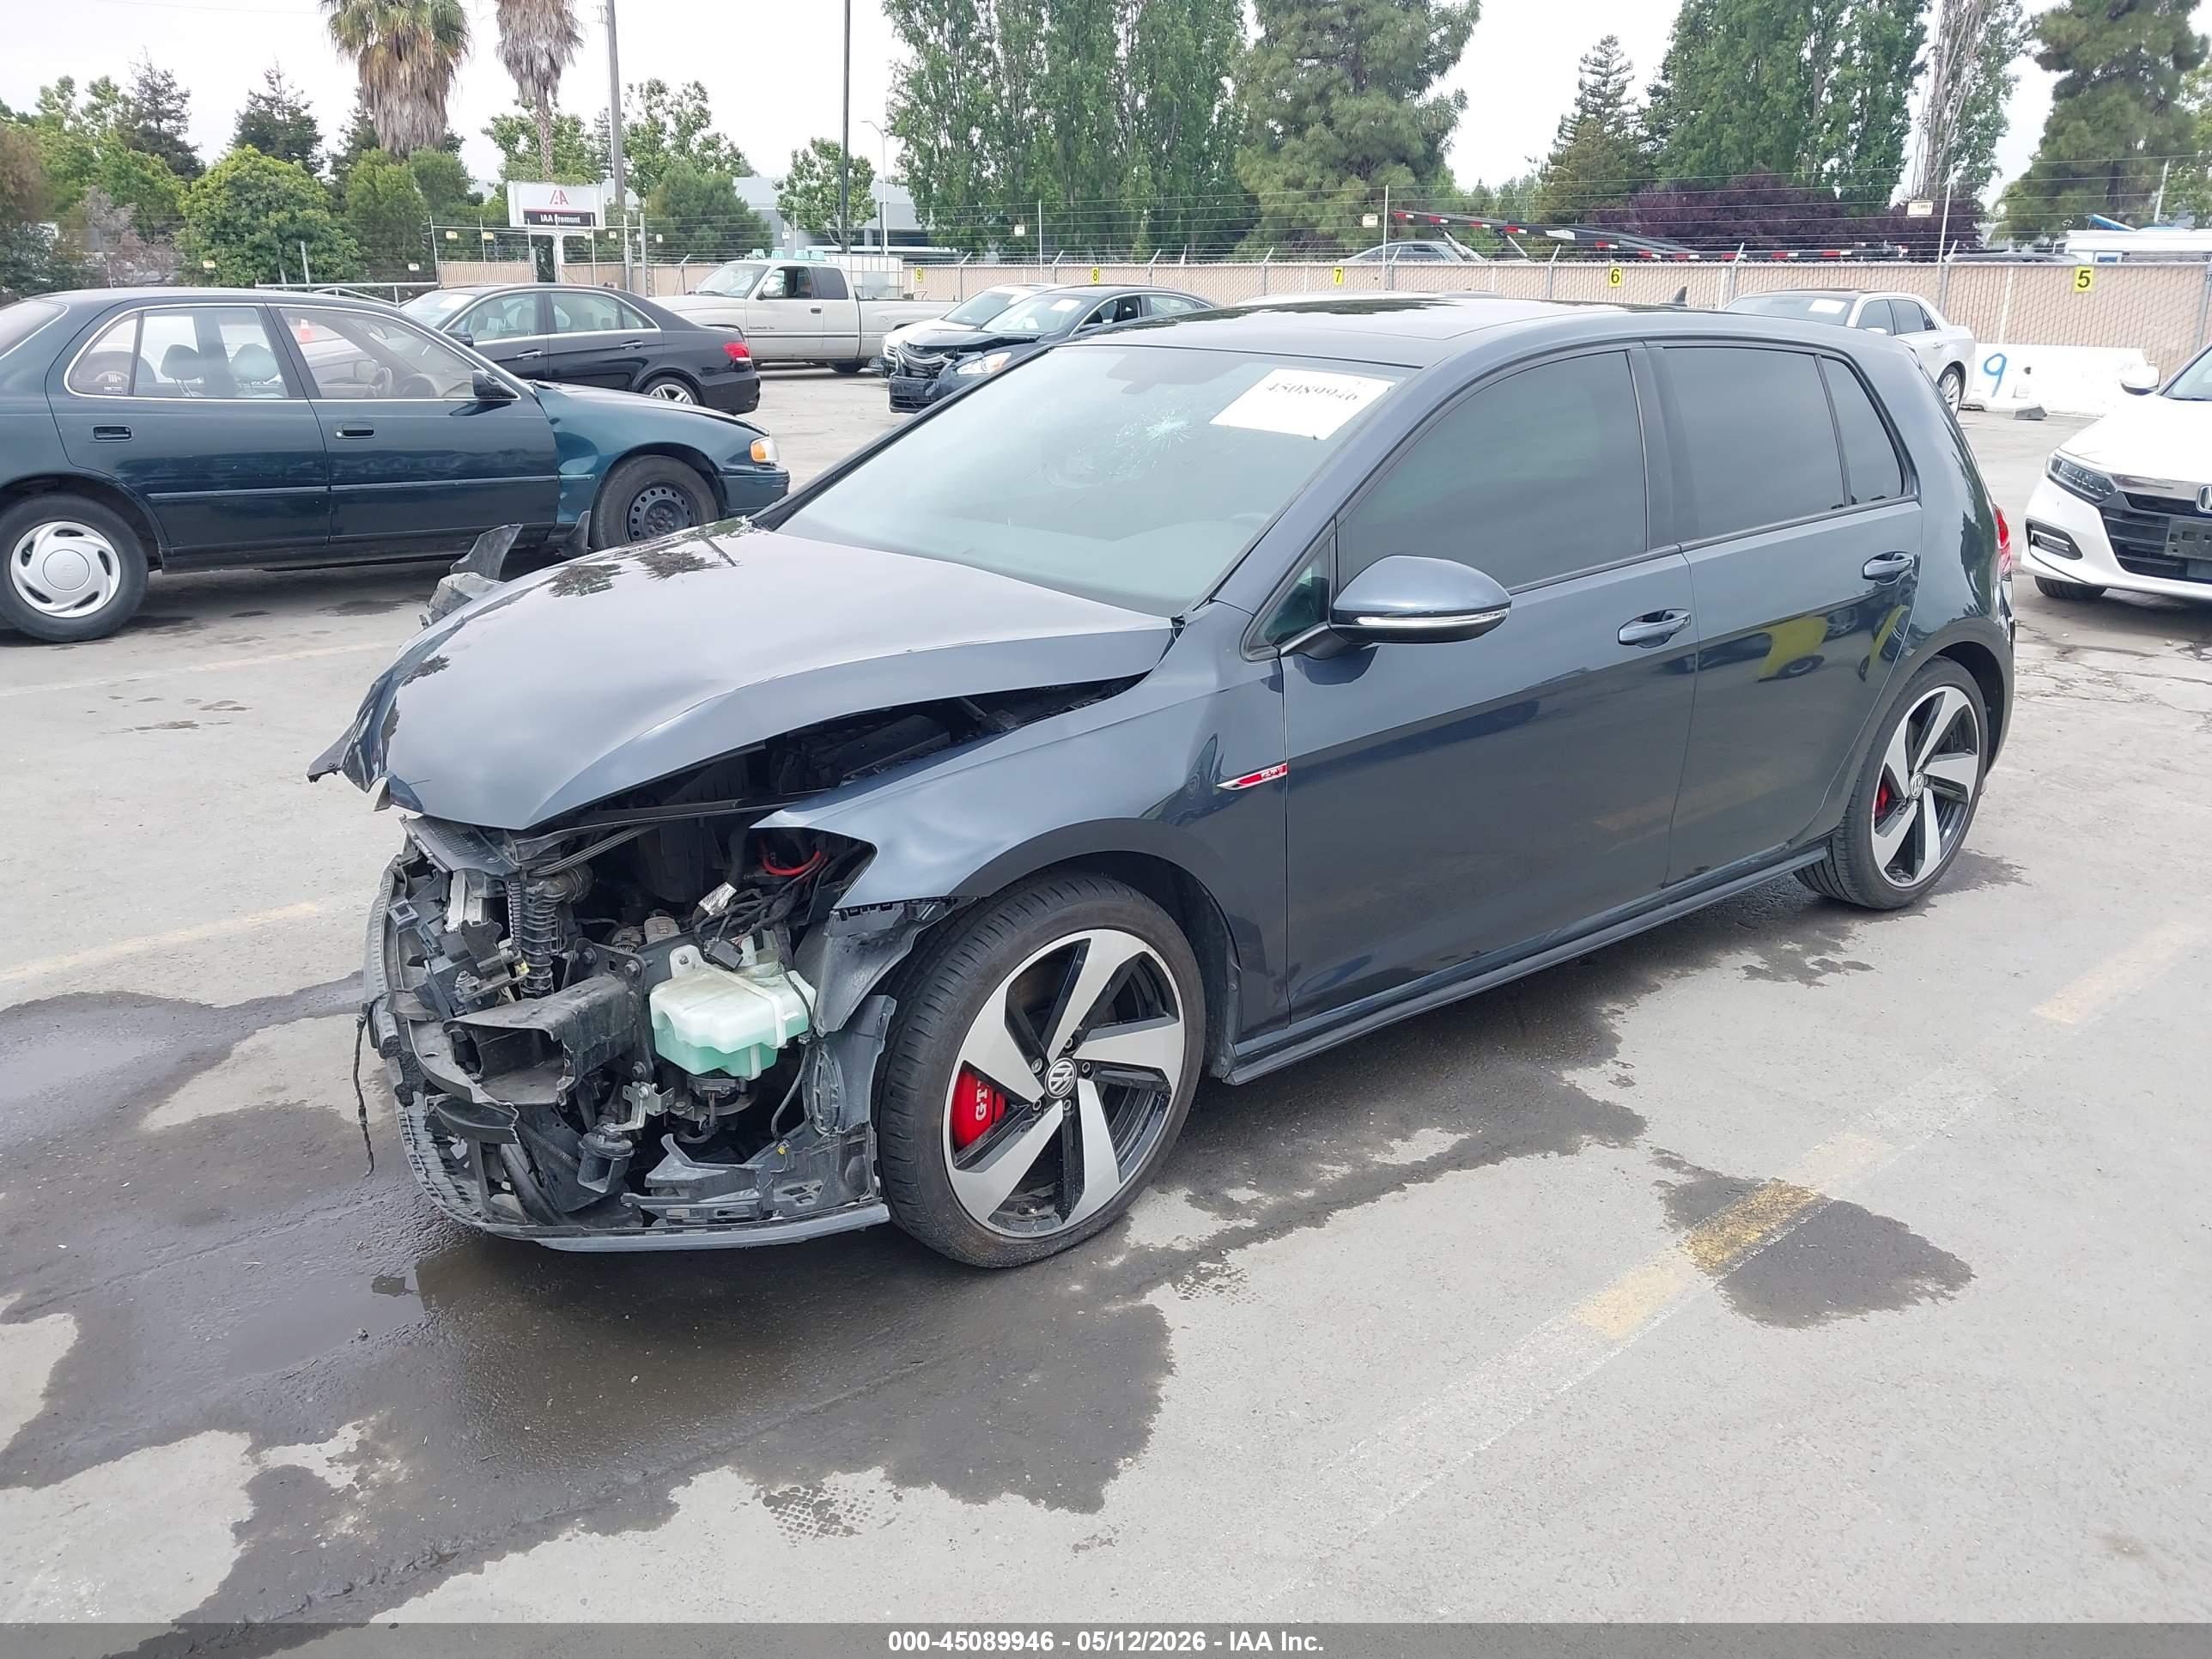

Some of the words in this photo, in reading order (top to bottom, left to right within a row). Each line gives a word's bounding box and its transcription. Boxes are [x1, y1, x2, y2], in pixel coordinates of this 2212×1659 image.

[540, 214, 553, 222] IAA
[1092, 269, 1098, 281] 8
[1335, 269, 1342, 283] 7
[1611, 268, 1620, 283] 6
[2077, 270, 2091, 289] 5
[1984, 352, 2008, 398] 9
